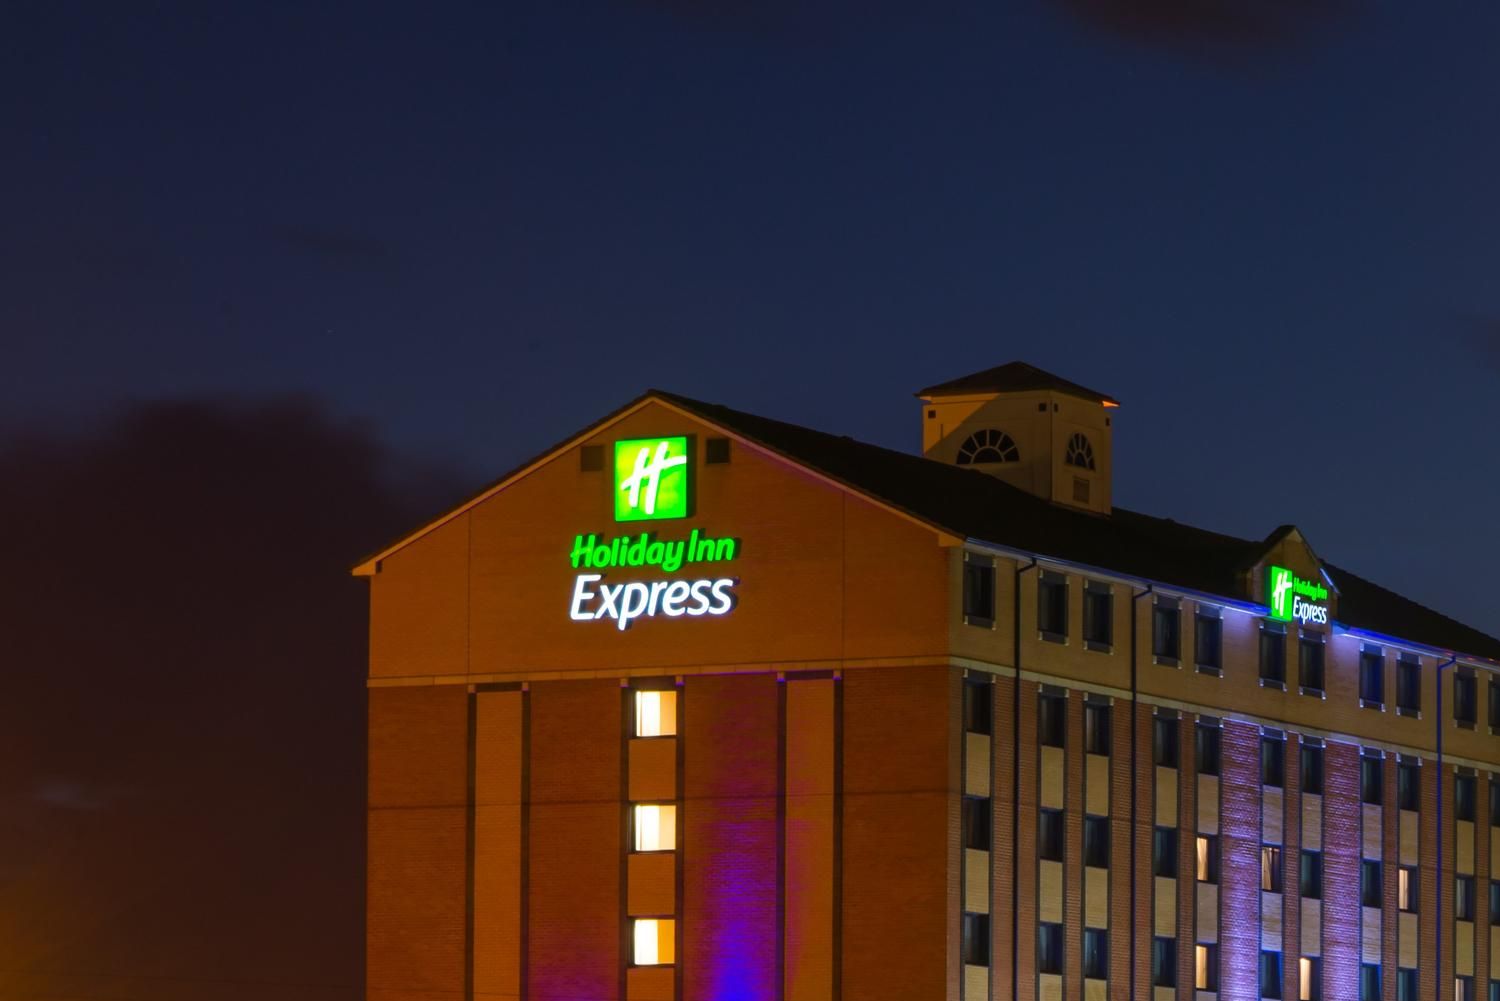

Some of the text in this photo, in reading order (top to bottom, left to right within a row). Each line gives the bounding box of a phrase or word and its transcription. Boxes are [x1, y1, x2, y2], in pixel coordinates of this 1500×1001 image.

[620, 441, 687, 515] H
[570, 528, 736, 572] Holiday Inn
[569, 573, 734, 631] Express
[1292, 595, 1327, 625] Express
